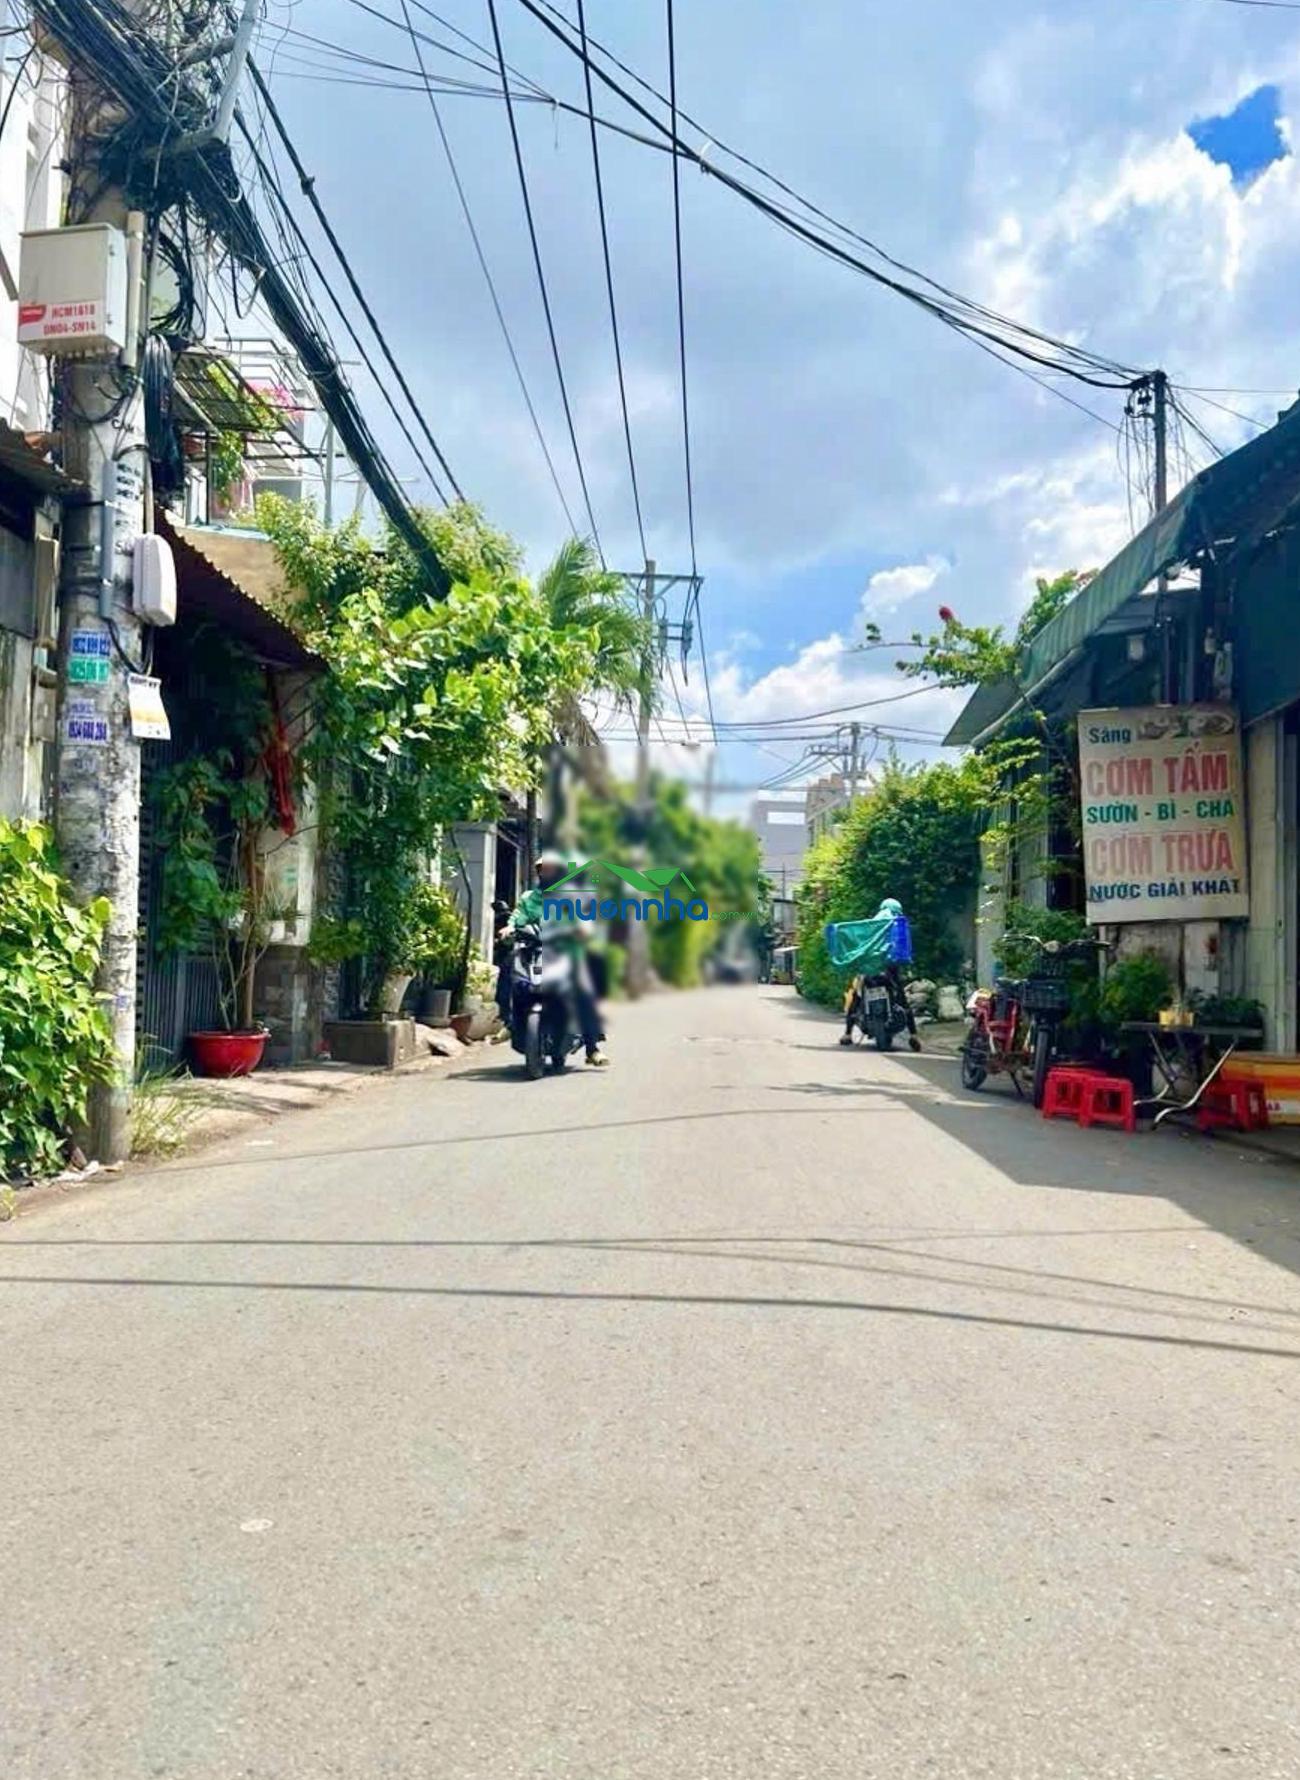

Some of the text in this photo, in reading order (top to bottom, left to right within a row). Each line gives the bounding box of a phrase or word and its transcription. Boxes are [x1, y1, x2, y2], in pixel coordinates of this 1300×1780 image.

[1086, 741, 1228, 797] CƠM TẤM
[1157, 802, 1176, 821] BÌ
[1090, 828, 1234, 876] CƠM TRƯA
